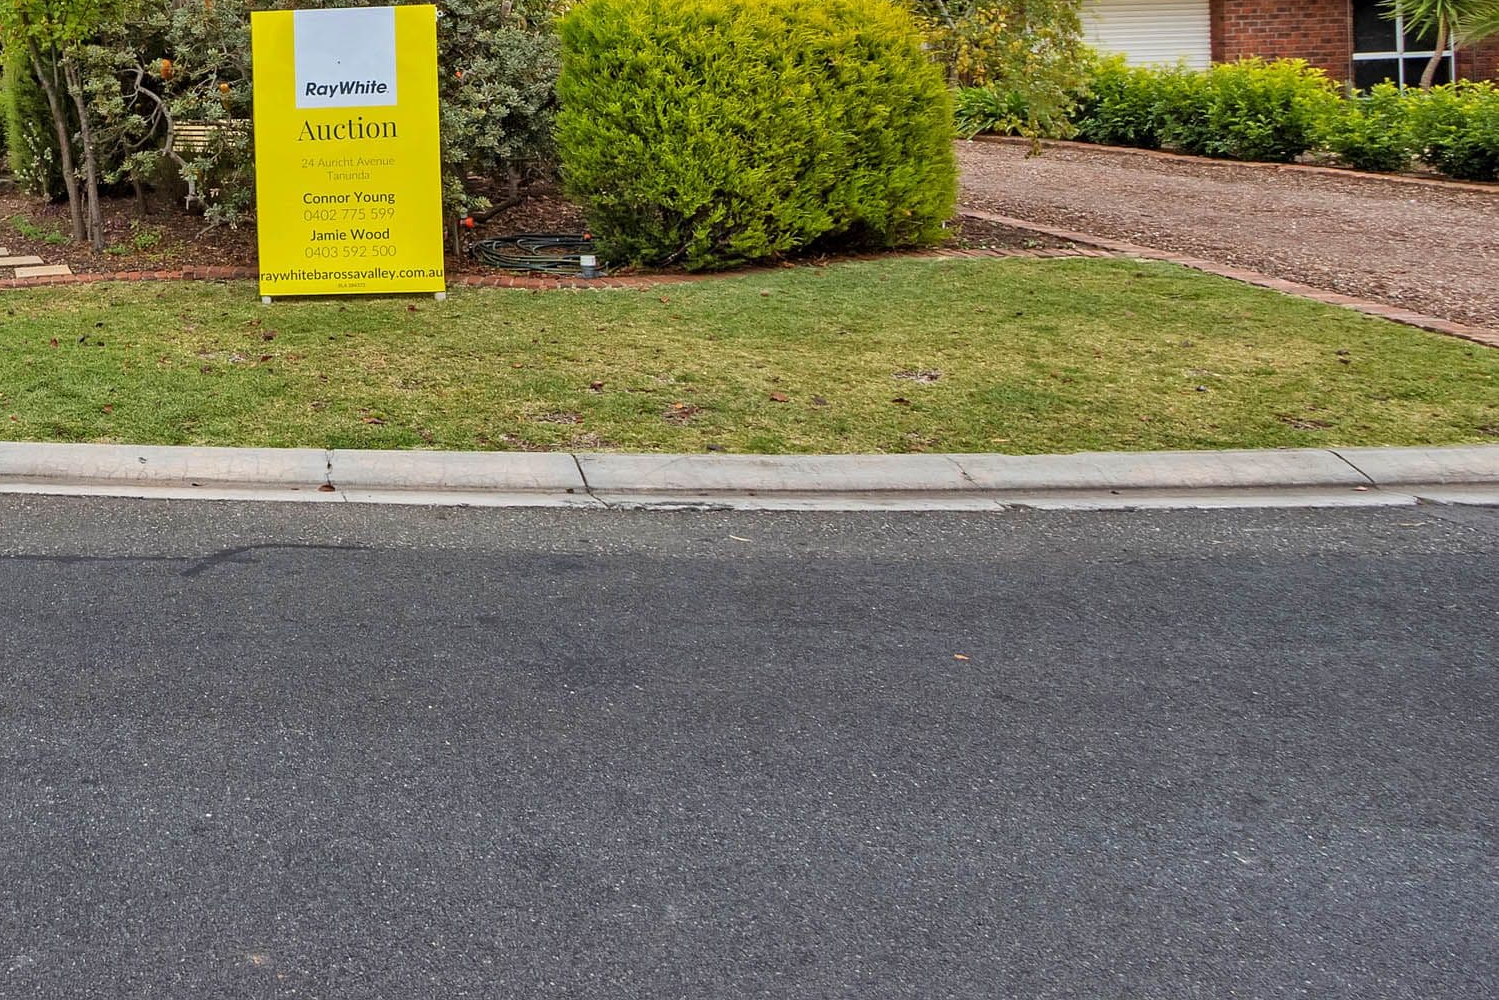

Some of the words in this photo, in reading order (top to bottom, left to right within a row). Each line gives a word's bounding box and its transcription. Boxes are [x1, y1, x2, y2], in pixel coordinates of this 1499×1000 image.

[298, 116, 398, 141] Auction
[301, 158, 314, 168] 24
[317, 157, 354, 168] Auricht
[357, 156, 396, 166] Avenue
[327, 171, 370, 181] Tanunda
[303, 193, 351, 205] Connor
[354, 192, 396, 205] Young
[304, 209, 337, 221] 0402
[341, 208, 366, 220] 775
[371, 207, 395, 220] 599
[310, 229, 347, 241] Jamie
[351, 228, 390, 240] Wood
[305, 246, 338, 258] 0403
[343, 245, 367, 258] 592
[372, 245, 397, 257] 500
[261, 268, 443, 283] raywhitebarossavalley.com.au
